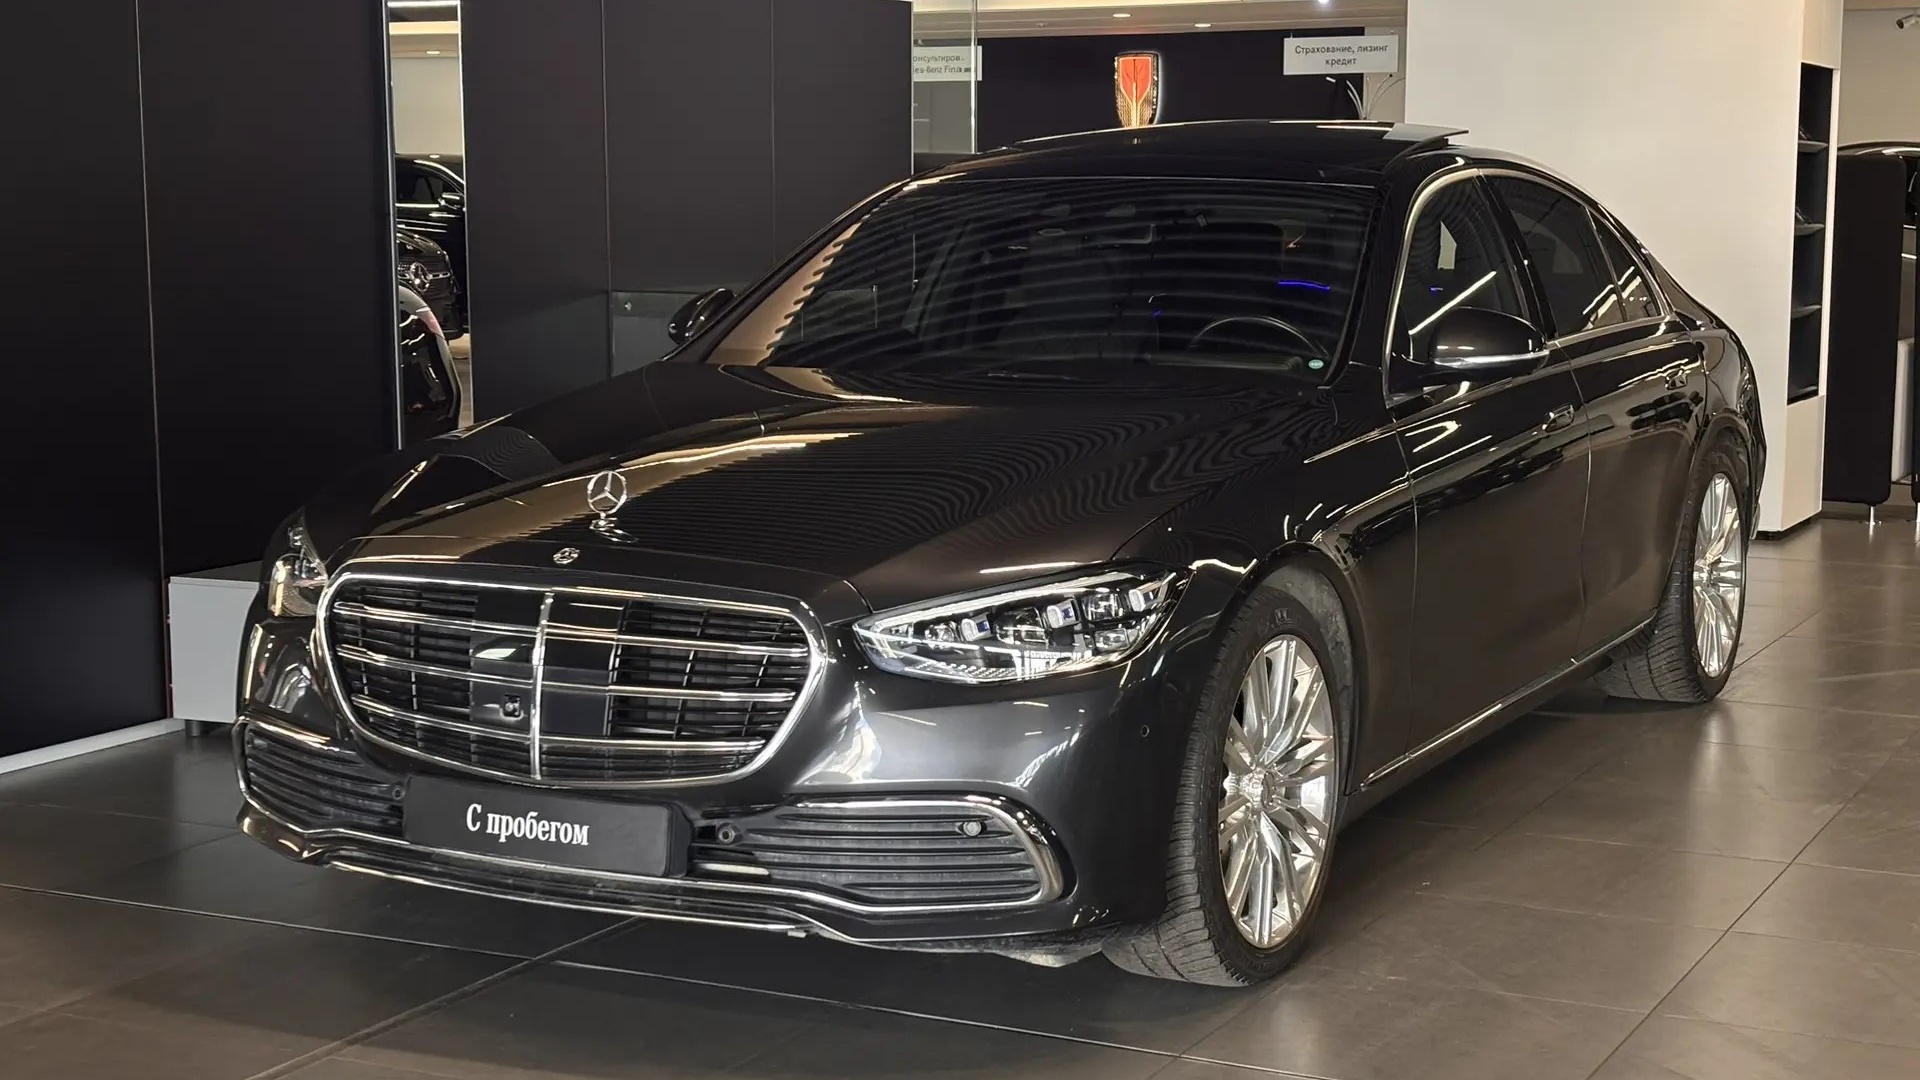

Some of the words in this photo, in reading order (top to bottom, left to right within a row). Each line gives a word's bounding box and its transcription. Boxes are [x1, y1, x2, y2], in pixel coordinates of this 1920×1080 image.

[1294, 45, 1355, 56] Страхование,
[1357, 44, 1389, 53] лизинг
[1325, 58, 1357, 67] кредит
[466, 803, 482, 831] С
[486, 811, 590, 846] пробегом
